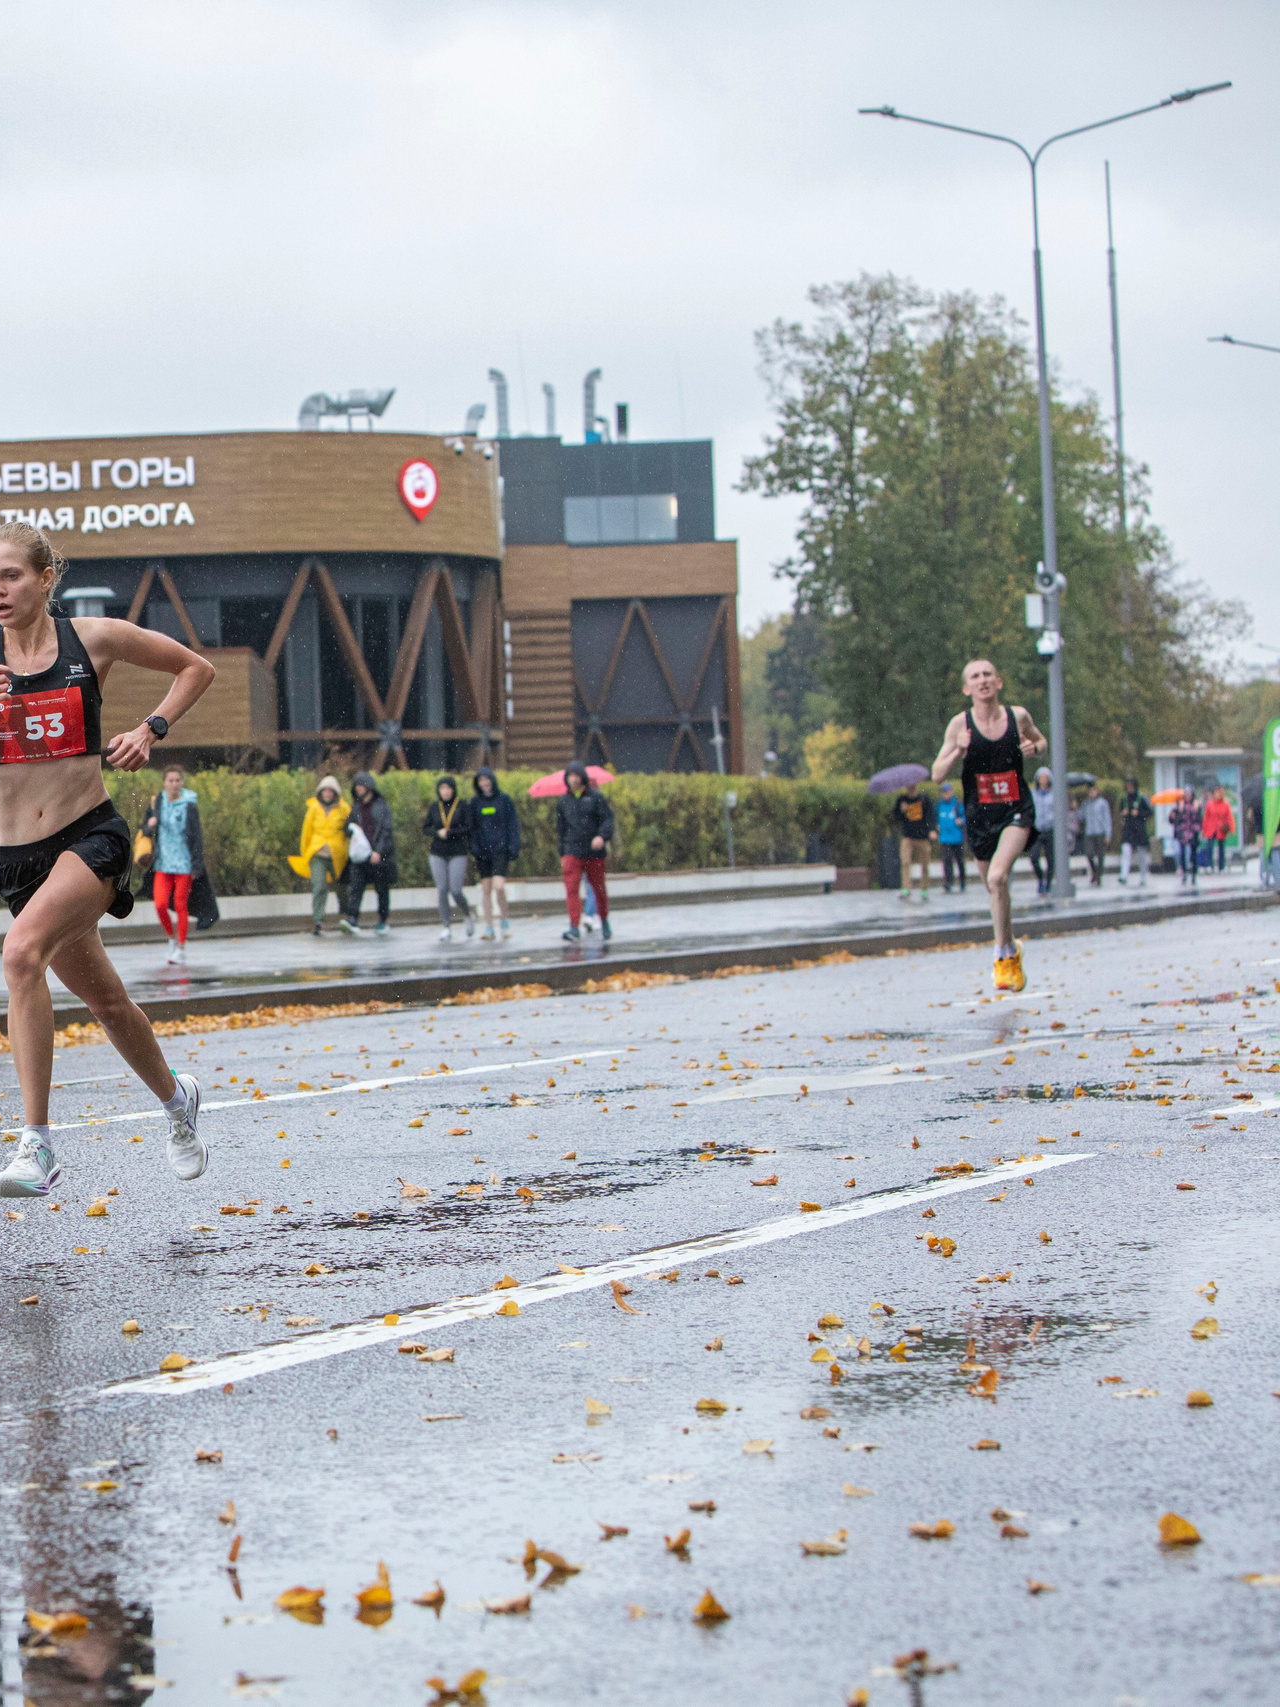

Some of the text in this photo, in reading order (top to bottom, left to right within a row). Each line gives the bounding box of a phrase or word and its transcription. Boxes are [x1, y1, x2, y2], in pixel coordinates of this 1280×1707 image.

[91, 456, 195, 490] ГОРЫ
[81, 502, 195, 534] ДОРОГА
[25, 712, 65, 740] 53
[992, 781, 1009, 795] 12
